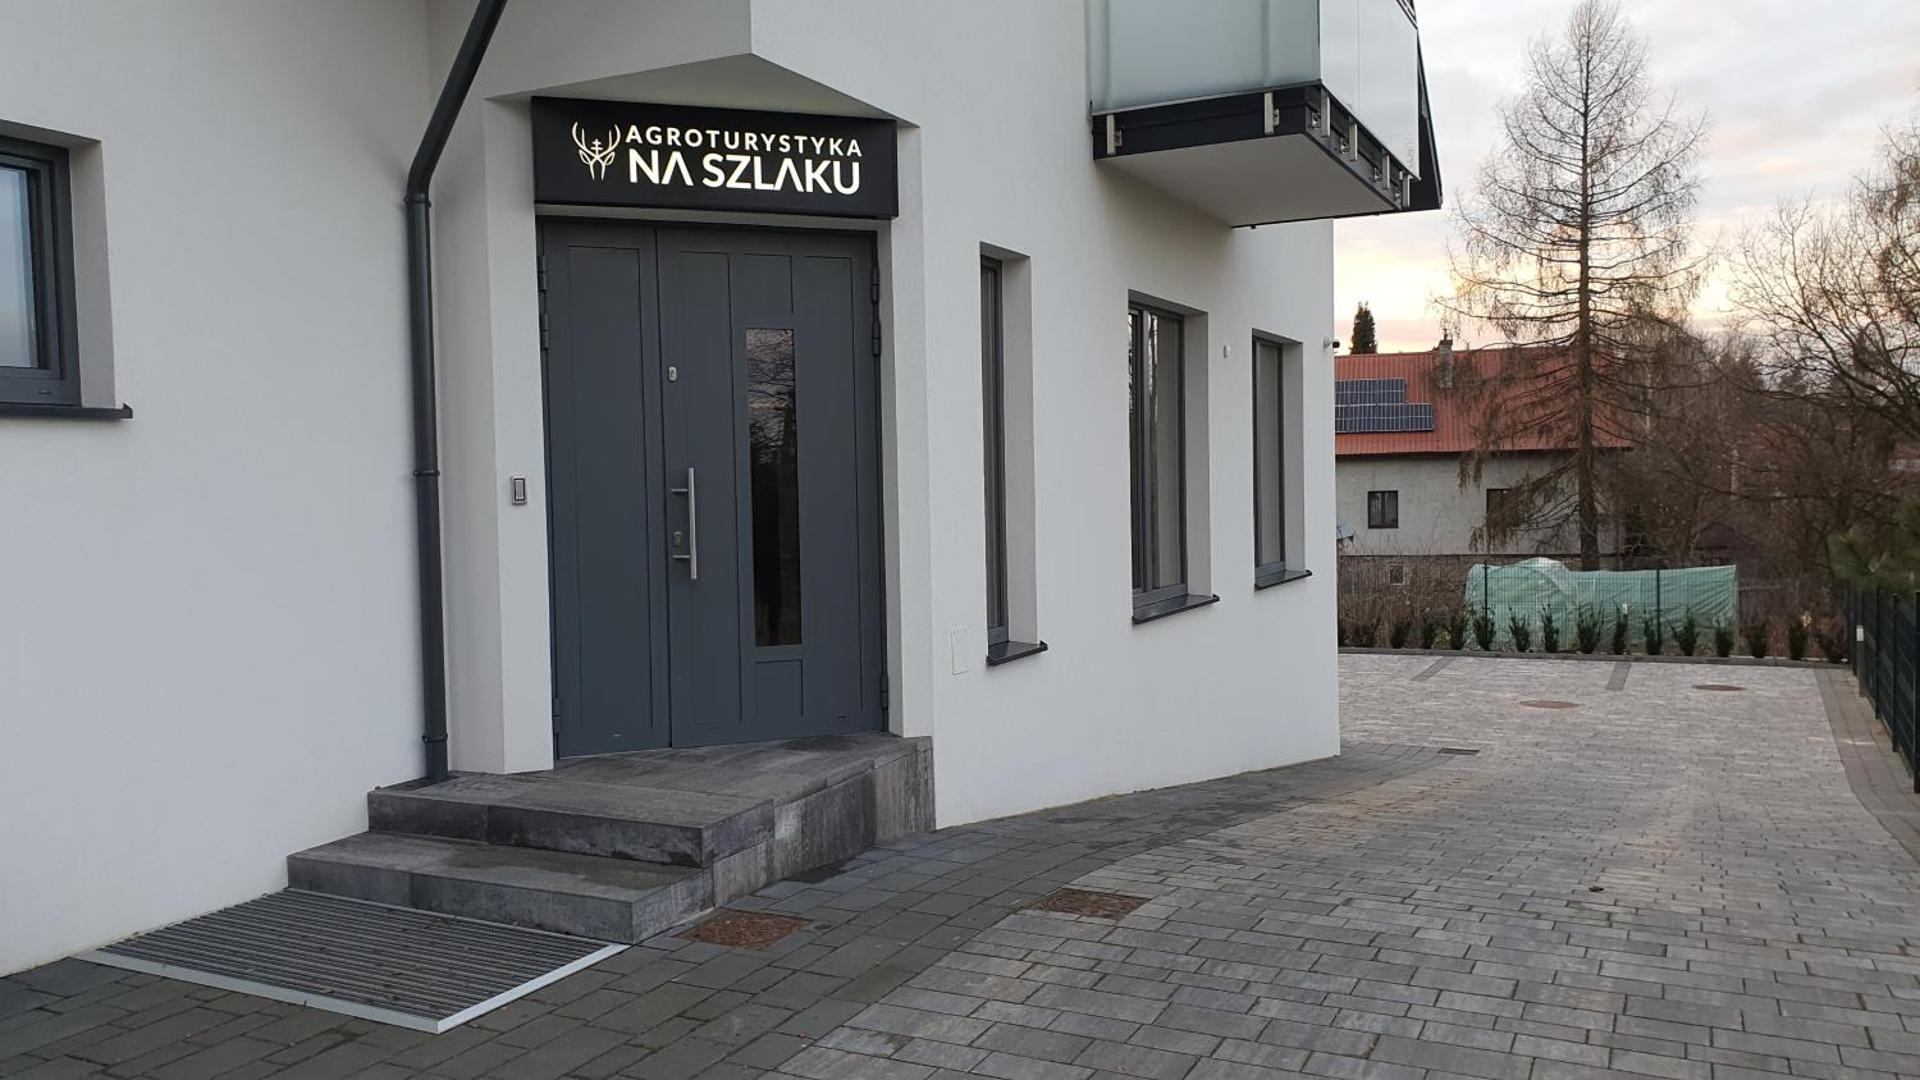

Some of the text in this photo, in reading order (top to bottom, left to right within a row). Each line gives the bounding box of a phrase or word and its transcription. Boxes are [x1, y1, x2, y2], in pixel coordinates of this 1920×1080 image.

[625, 124, 863, 158] AGROTURYSTYKA
[628, 148, 861, 195] NA SZLAKU
